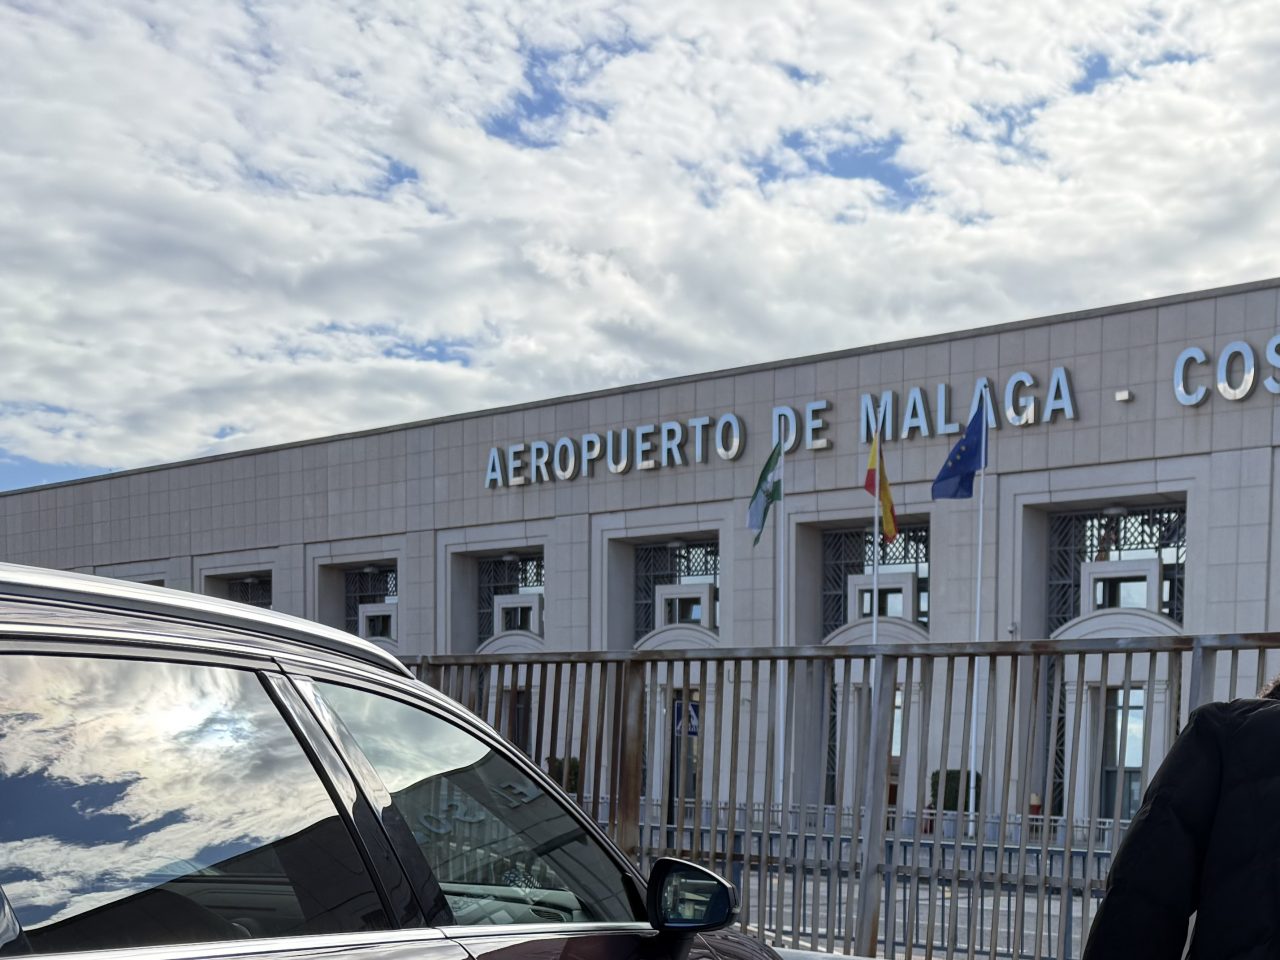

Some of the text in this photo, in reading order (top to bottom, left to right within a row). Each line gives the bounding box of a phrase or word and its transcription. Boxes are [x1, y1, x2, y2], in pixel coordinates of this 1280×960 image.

[485, 411, 743, 489] AEROPUERTO
[772, 400, 831, 455] DE
[860, 366, 1076, 443] MALAGA
